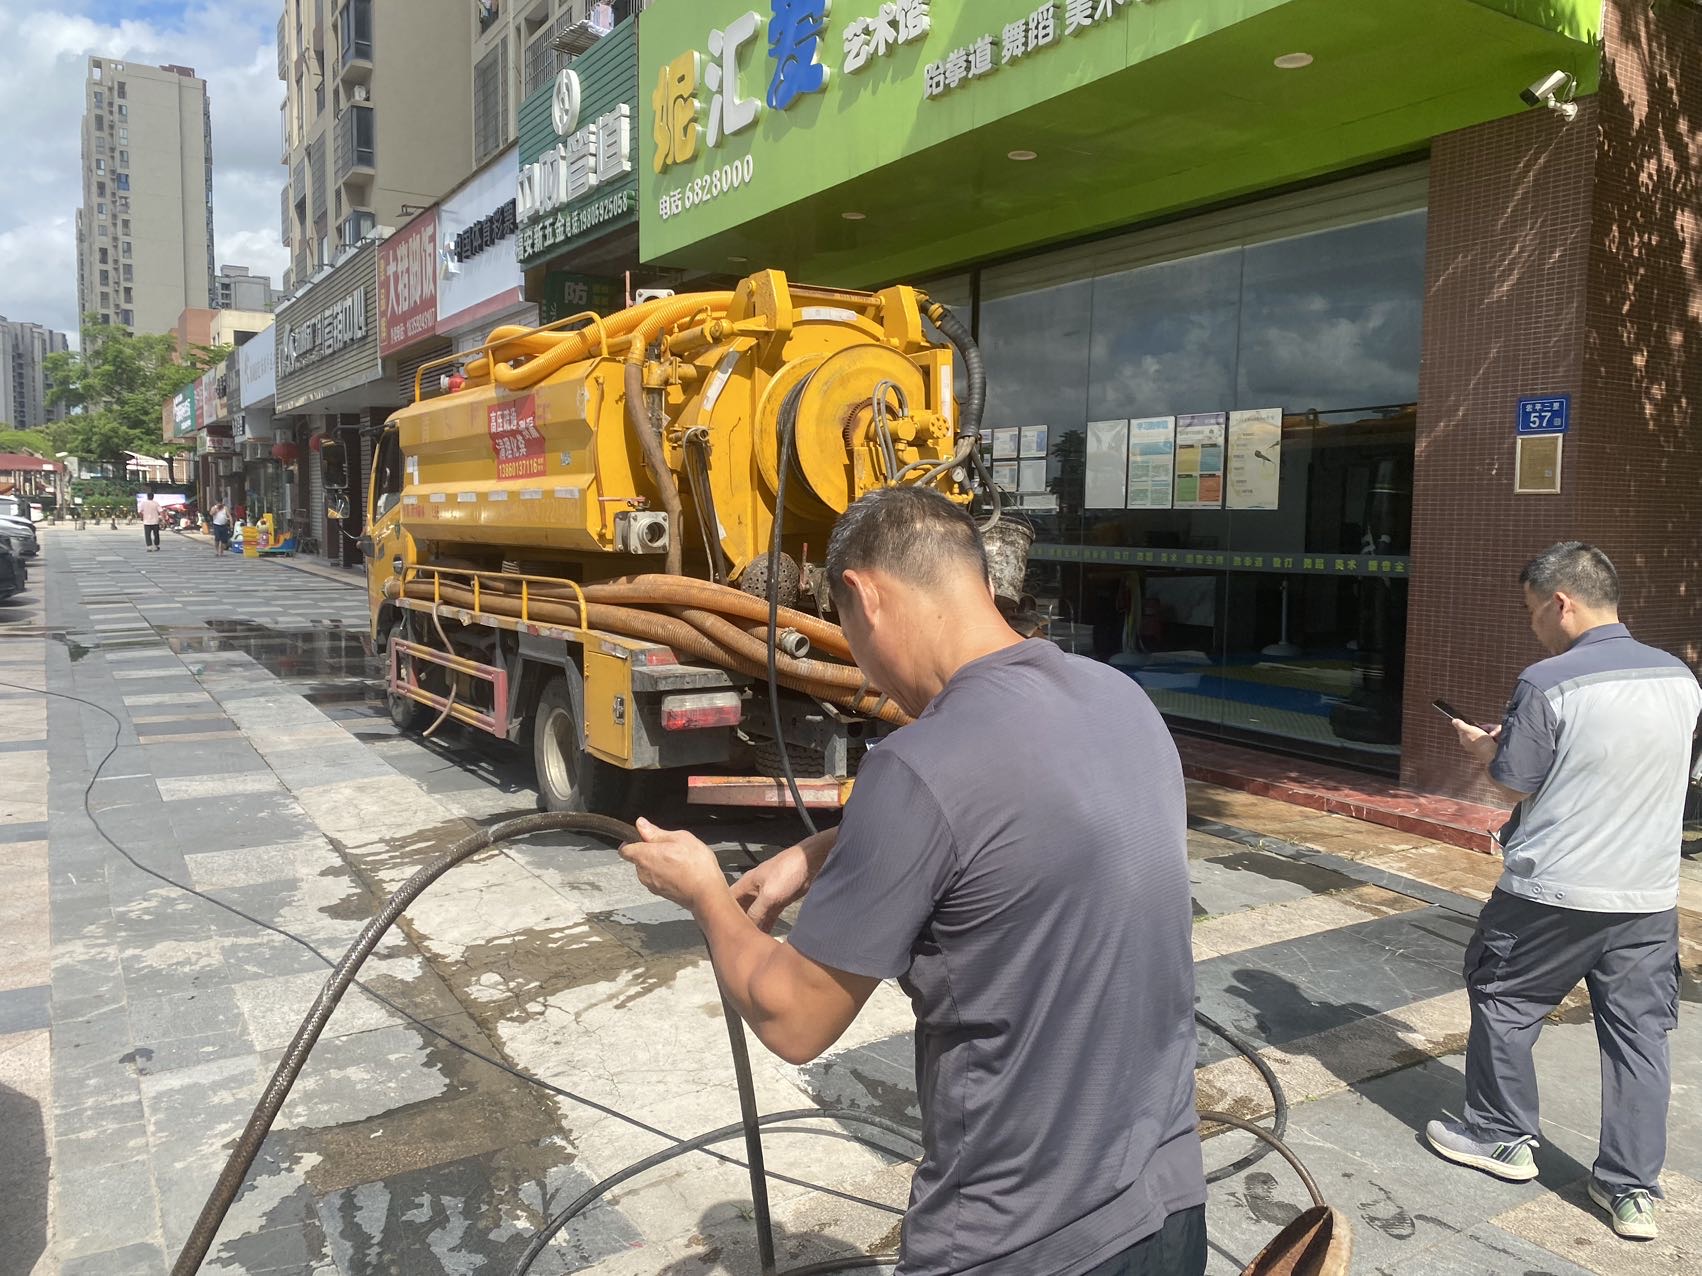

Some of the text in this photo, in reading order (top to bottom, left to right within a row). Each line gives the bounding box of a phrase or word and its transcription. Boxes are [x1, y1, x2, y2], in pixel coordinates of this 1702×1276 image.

[1001, 2, 1058, 65] 舞蹈
[659, 154, 754, 220] 电话 6828000
[454, 198, 517, 262] 中国体育彩票
[1529, 412, 1552, 428] 57
